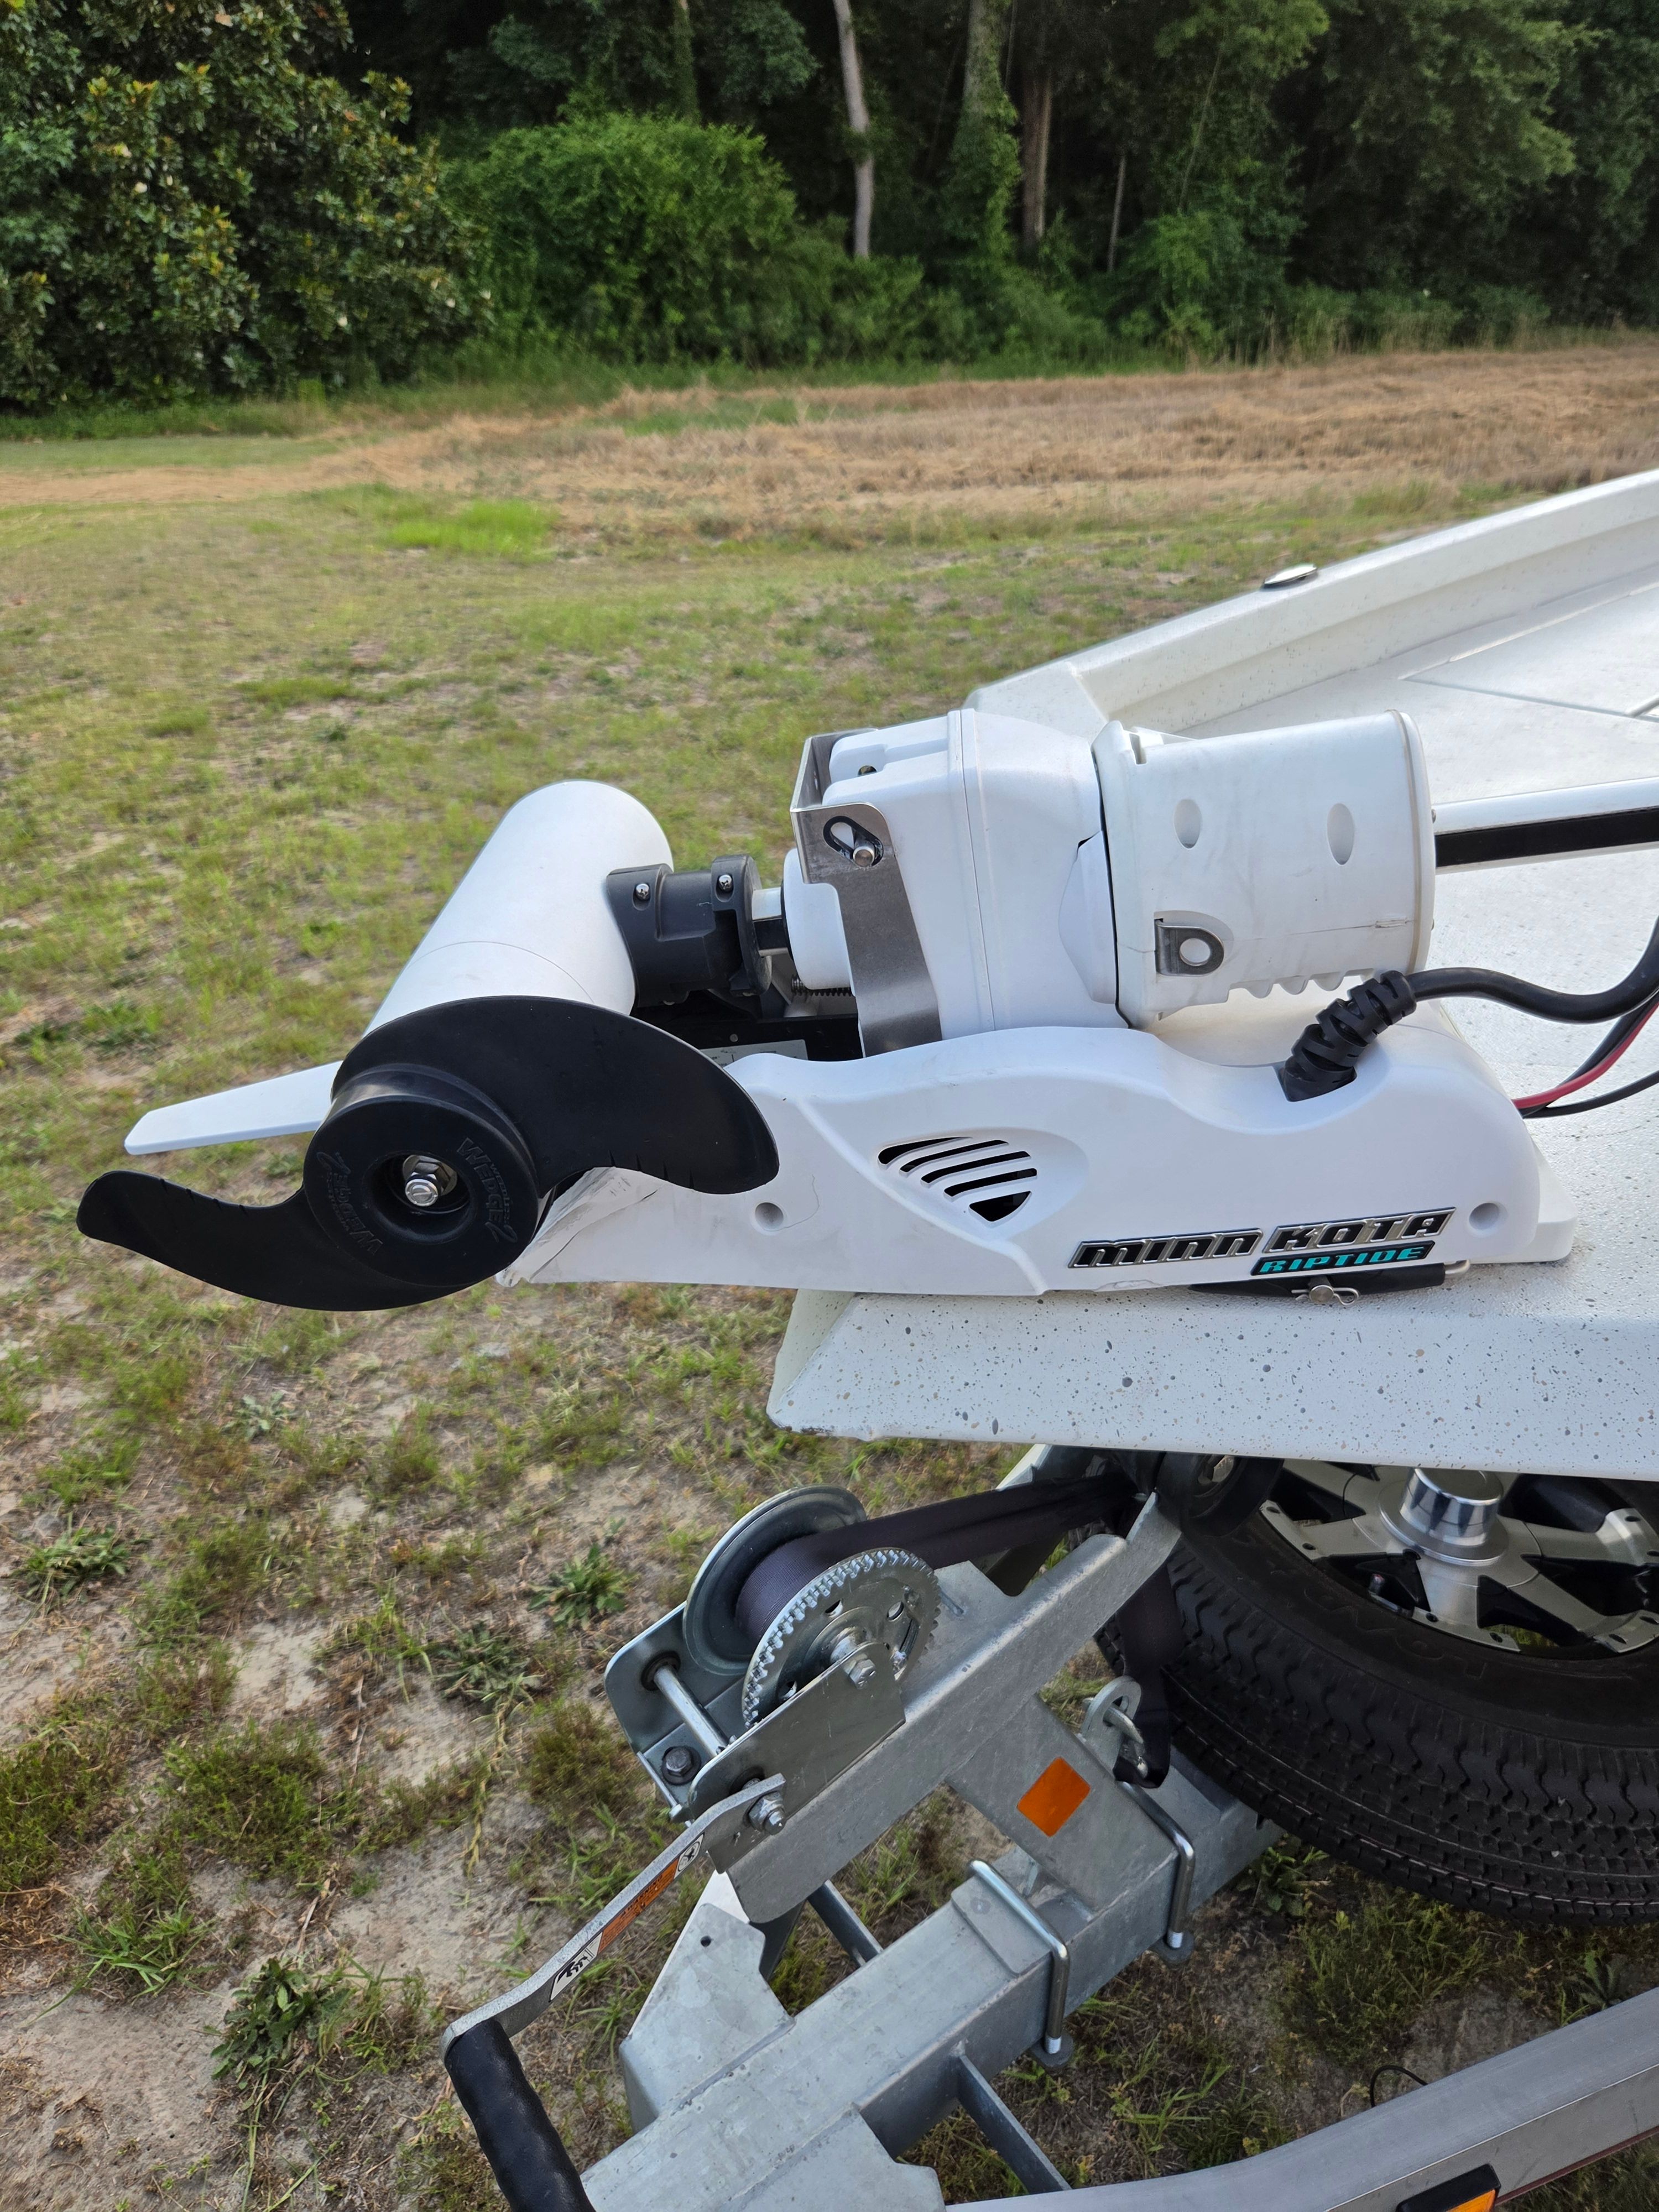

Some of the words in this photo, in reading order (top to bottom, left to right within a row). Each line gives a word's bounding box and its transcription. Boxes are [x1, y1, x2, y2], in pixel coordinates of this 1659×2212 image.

[457, 1137, 504, 1222] WEDGE
[1070, 1229, 1263, 1269] MINN
[1263, 1207, 1455, 1253] KOTA
[1259, 1246, 1426, 1273] RIPTIDE
